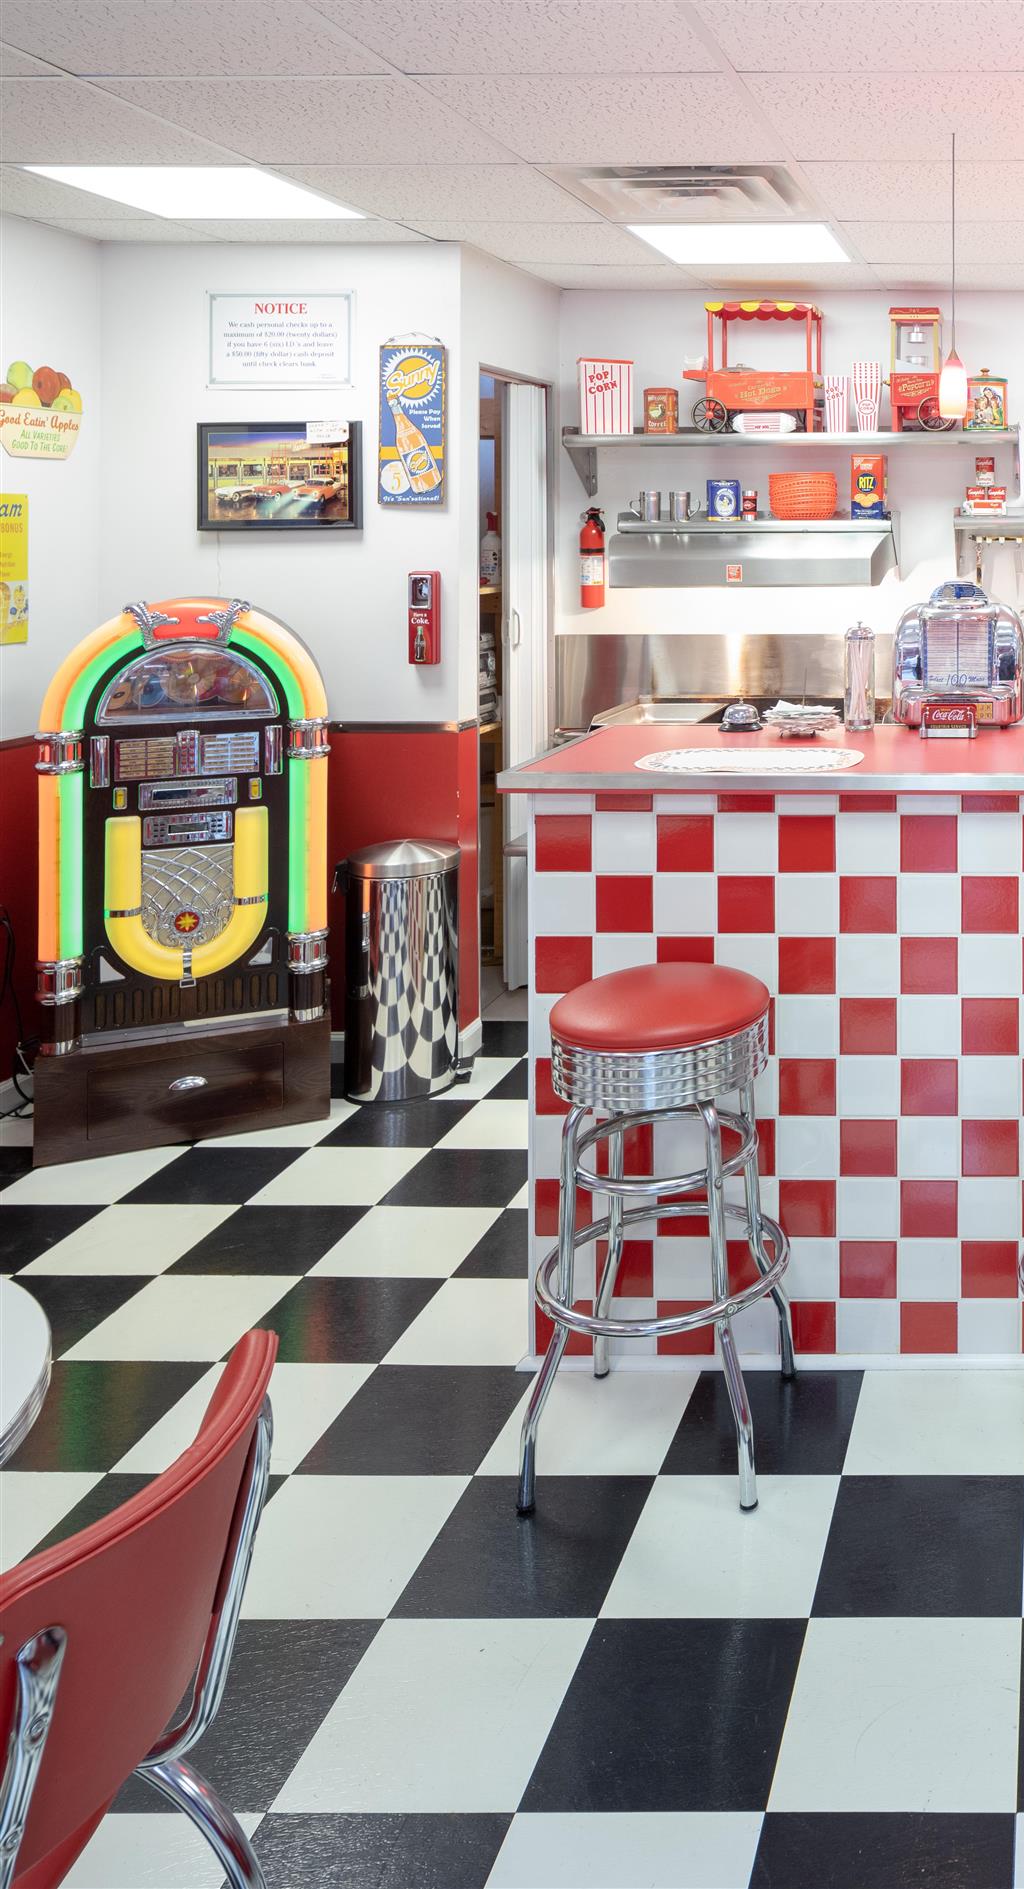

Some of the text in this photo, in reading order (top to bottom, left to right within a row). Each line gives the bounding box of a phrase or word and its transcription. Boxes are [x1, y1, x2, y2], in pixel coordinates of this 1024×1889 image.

[254, 303, 308, 314] NOTICE
[257, 321, 284, 330] personal
[386, 360, 440, 400] Sunny
[588, 371, 609, 383] POP
[588, 380, 618, 394] CORN
[759, 386, 781, 394] Dogs
[902, 380, 931, 391] Popcorn
[826, 392, 844, 400] CORN
[24, 412, 48, 427] Eatin'
[51, 416, 78, 432] Apples
[12, 440, 28, 449] GOOD
[392, 472, 400, 490] 5
[858, 476, 874, 488] RITZ
[1, 523, 23, 534] BONUS
[946, 674, 967, 686] 100
[932, 709, 965, 720] Coca-Cola
